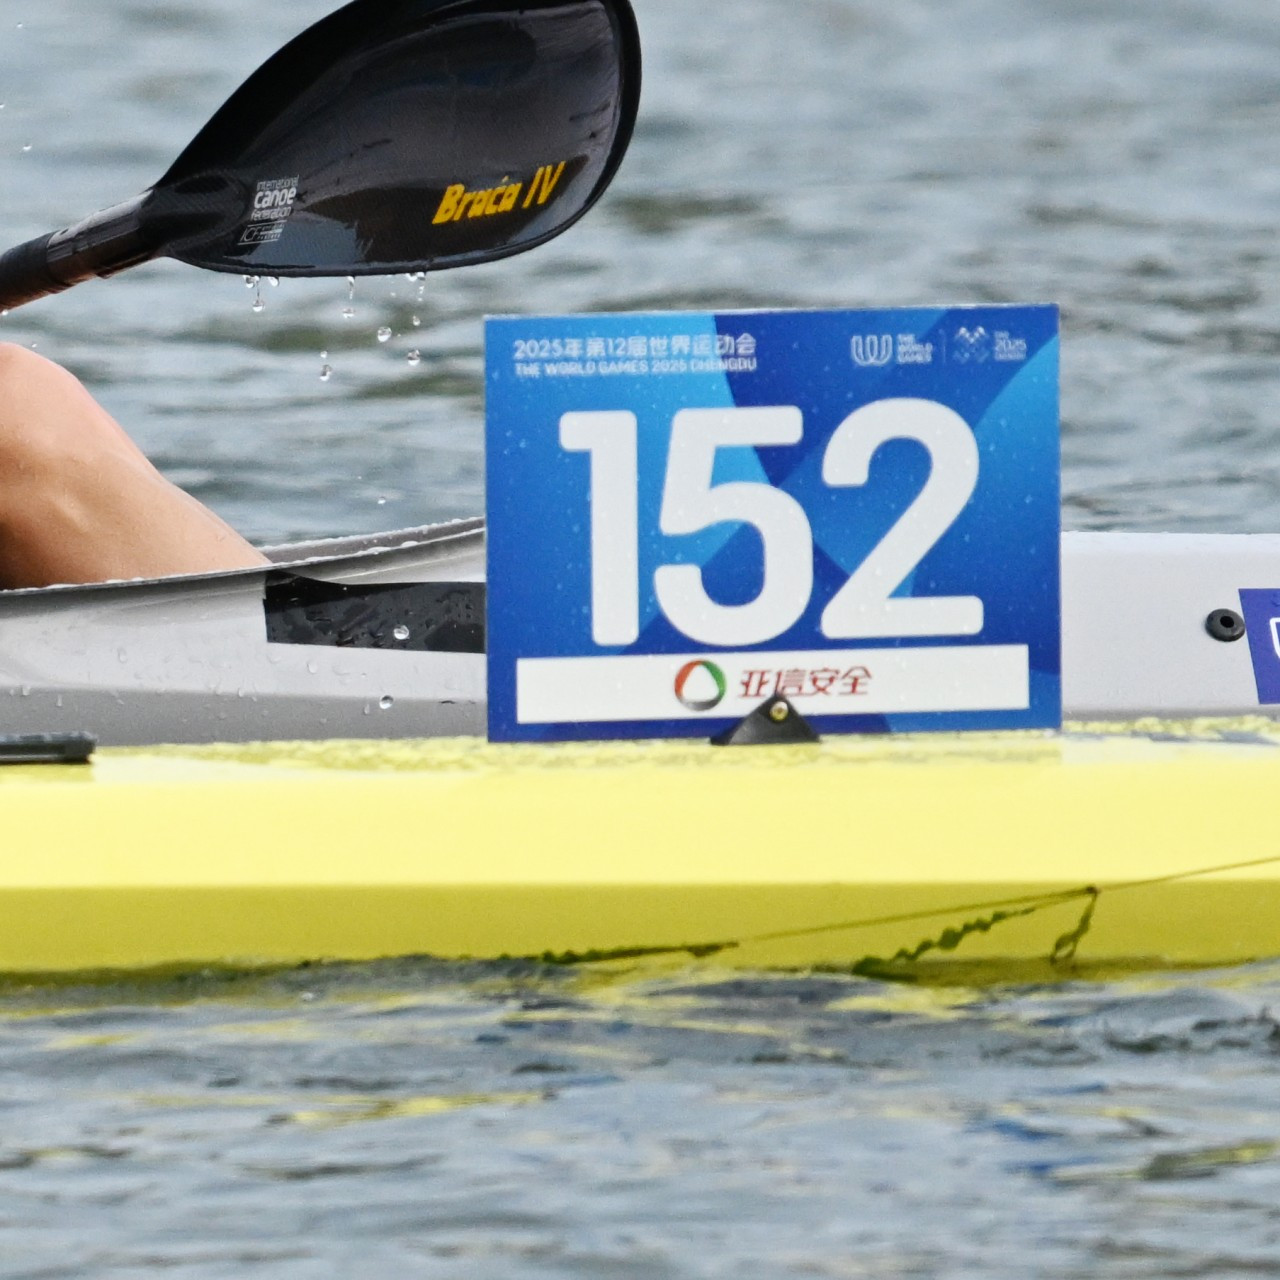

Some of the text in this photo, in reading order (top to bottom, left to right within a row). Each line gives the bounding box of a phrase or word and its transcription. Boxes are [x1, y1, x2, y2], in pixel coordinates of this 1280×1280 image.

[254, 187, 297, 208] canoe
[521, 160, 567, 209] IV
[545, 361, 596, 376] WORLD
[598, 359, 649, 375] GAMES
[651, 358, 687, 373] 2025
[559, 396, 985, 646] 152
[738, 665, 872, 698] 亚信安全
